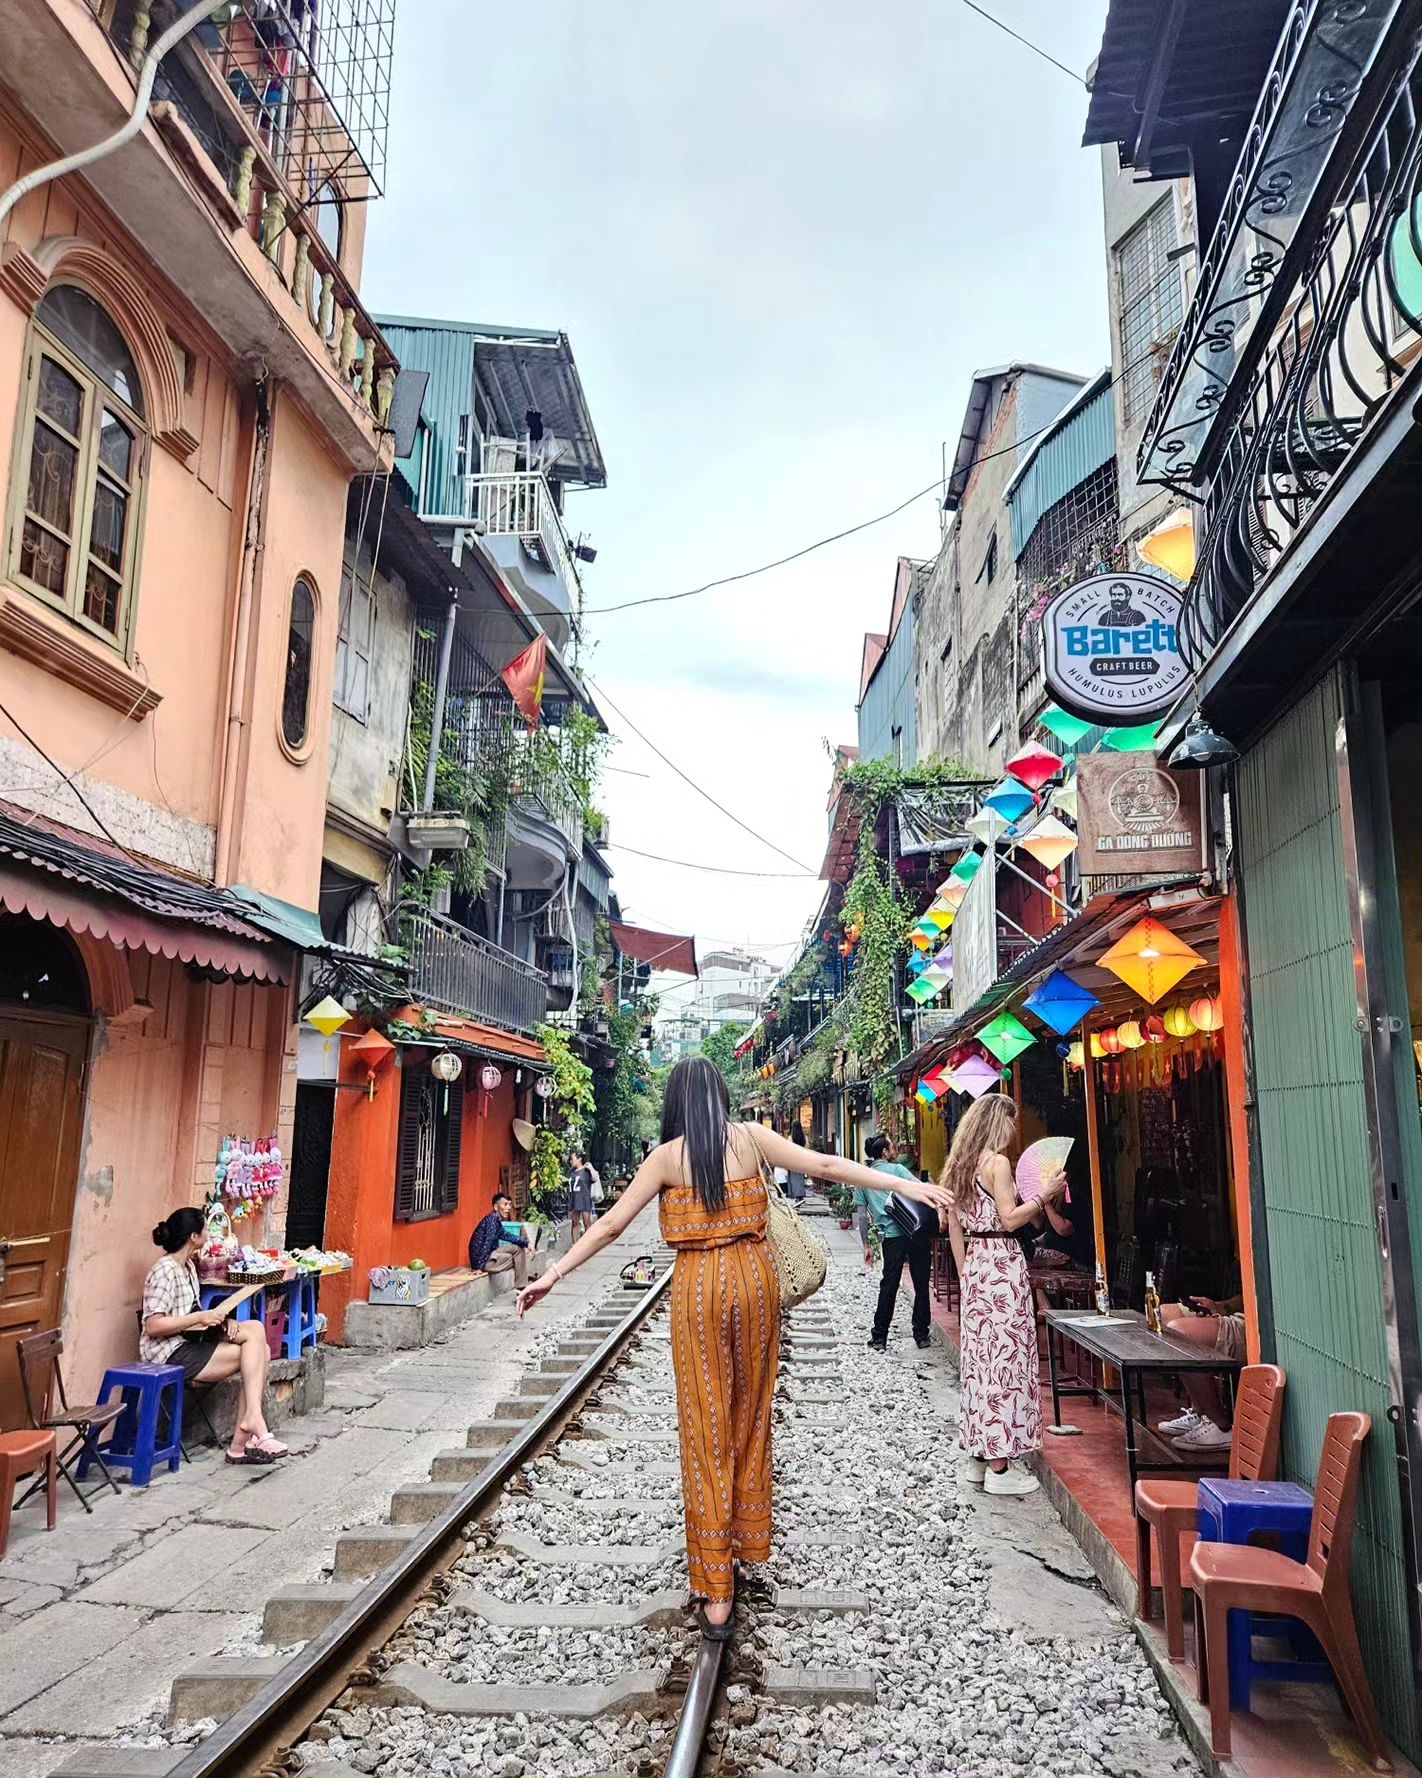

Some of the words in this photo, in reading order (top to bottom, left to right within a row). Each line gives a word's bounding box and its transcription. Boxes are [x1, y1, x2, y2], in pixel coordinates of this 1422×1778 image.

[1065, 590, 1101, 618] SMALL
[1137, 587, 1176, 614] BATCH
[1096, 662, 1128, 671] CRAFT
[1128, 661, 1153, 671] BEER
[1067, 668, 1123, 698] HUMULUS
[1131, 666, 1181, 698] LUPULUS
[1097, 835, 1113, 850] GA
